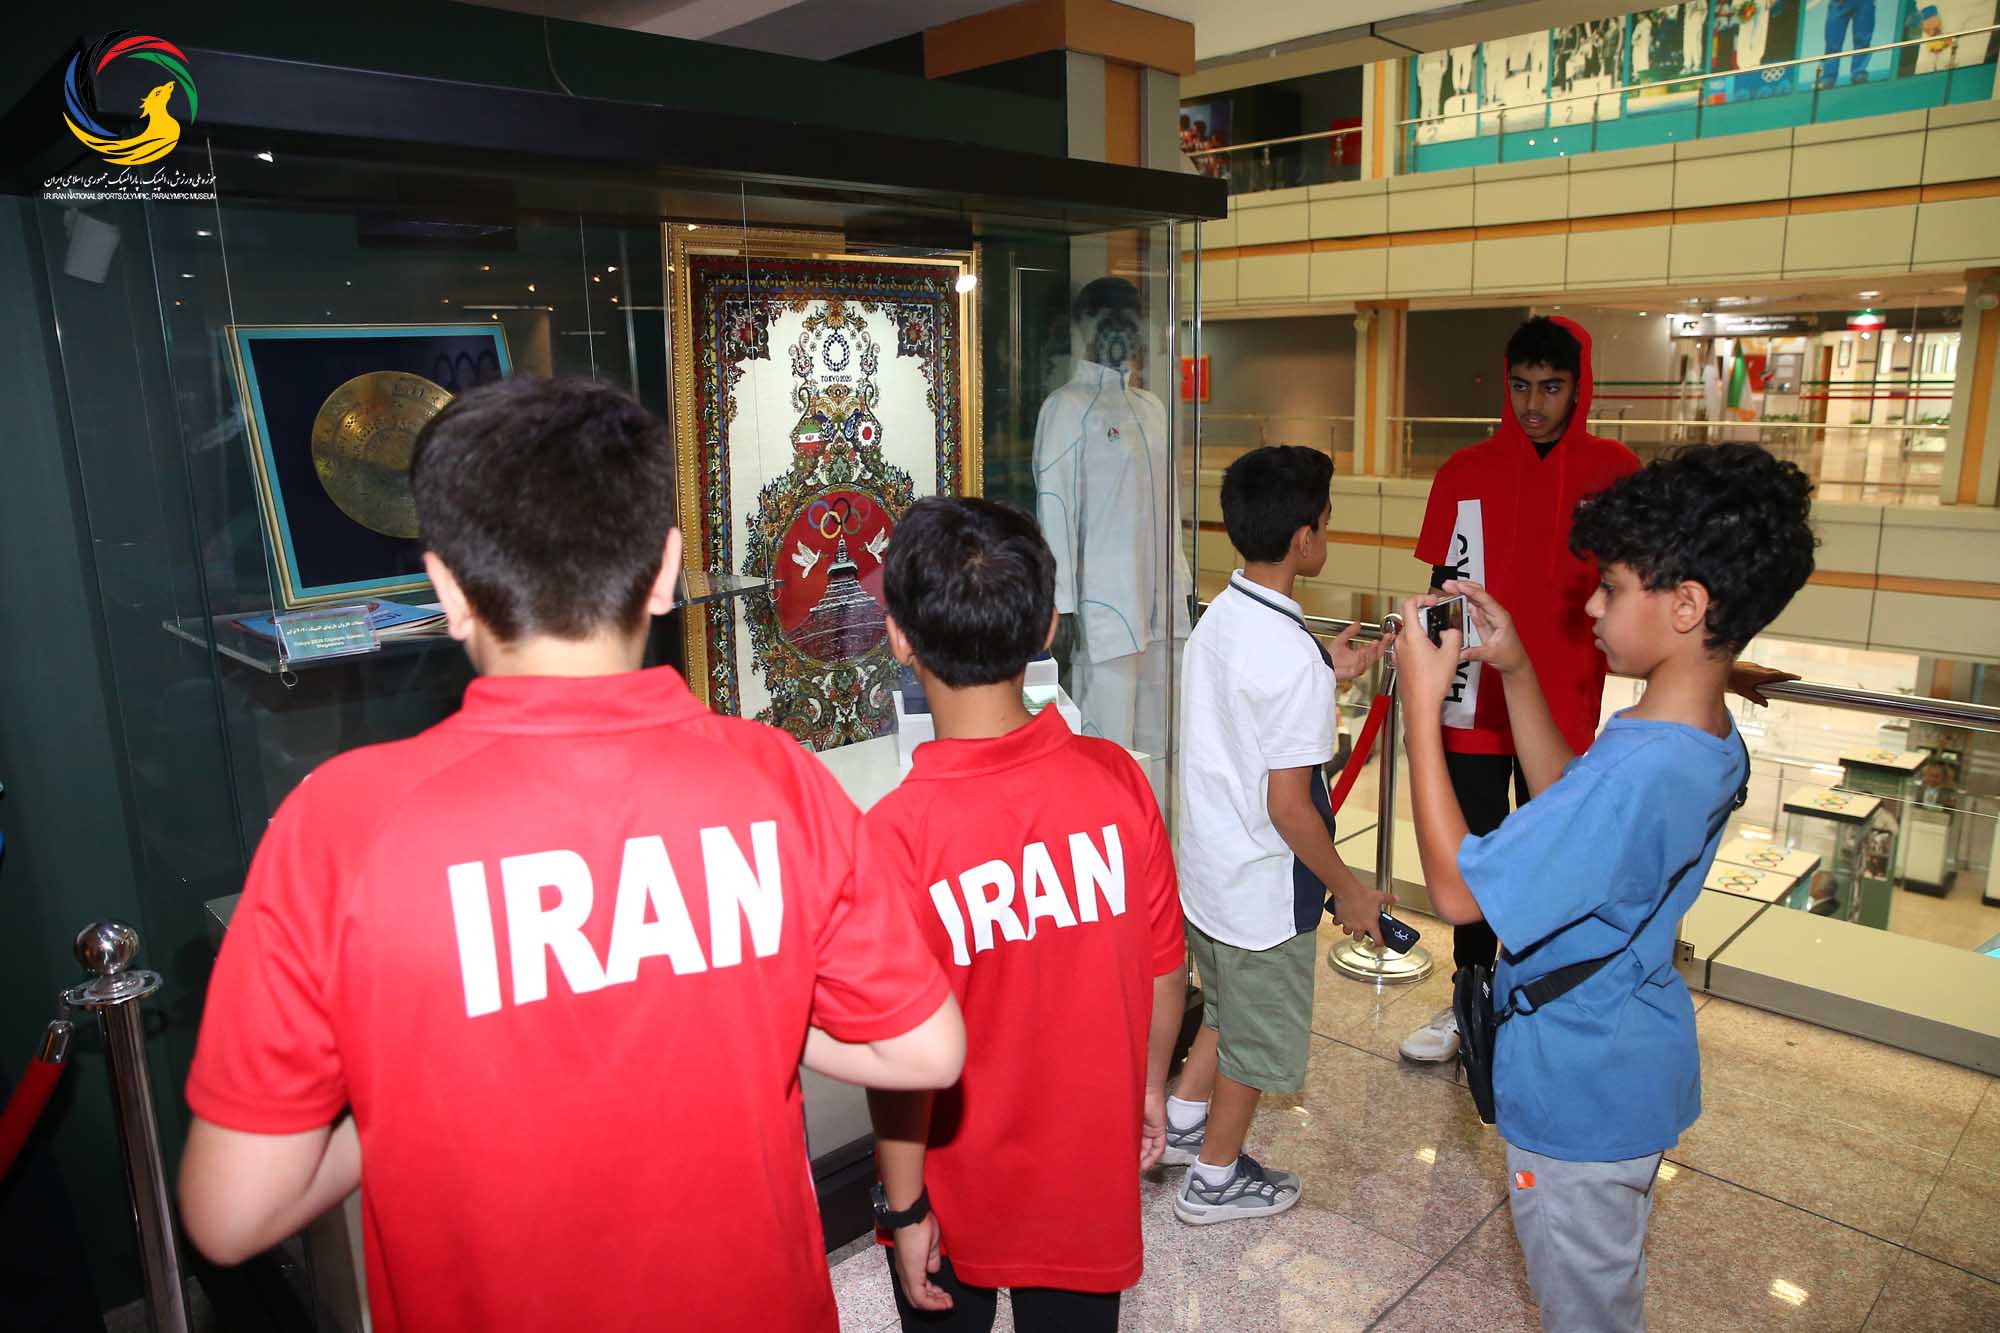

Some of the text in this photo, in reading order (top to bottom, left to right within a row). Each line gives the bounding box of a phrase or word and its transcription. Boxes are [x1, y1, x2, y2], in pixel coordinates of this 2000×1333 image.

[820, 375, 840, 383] TOKYO
[447, 819, 784, 1018] IRAN
[928, 823, 1126, 966] IRAN
